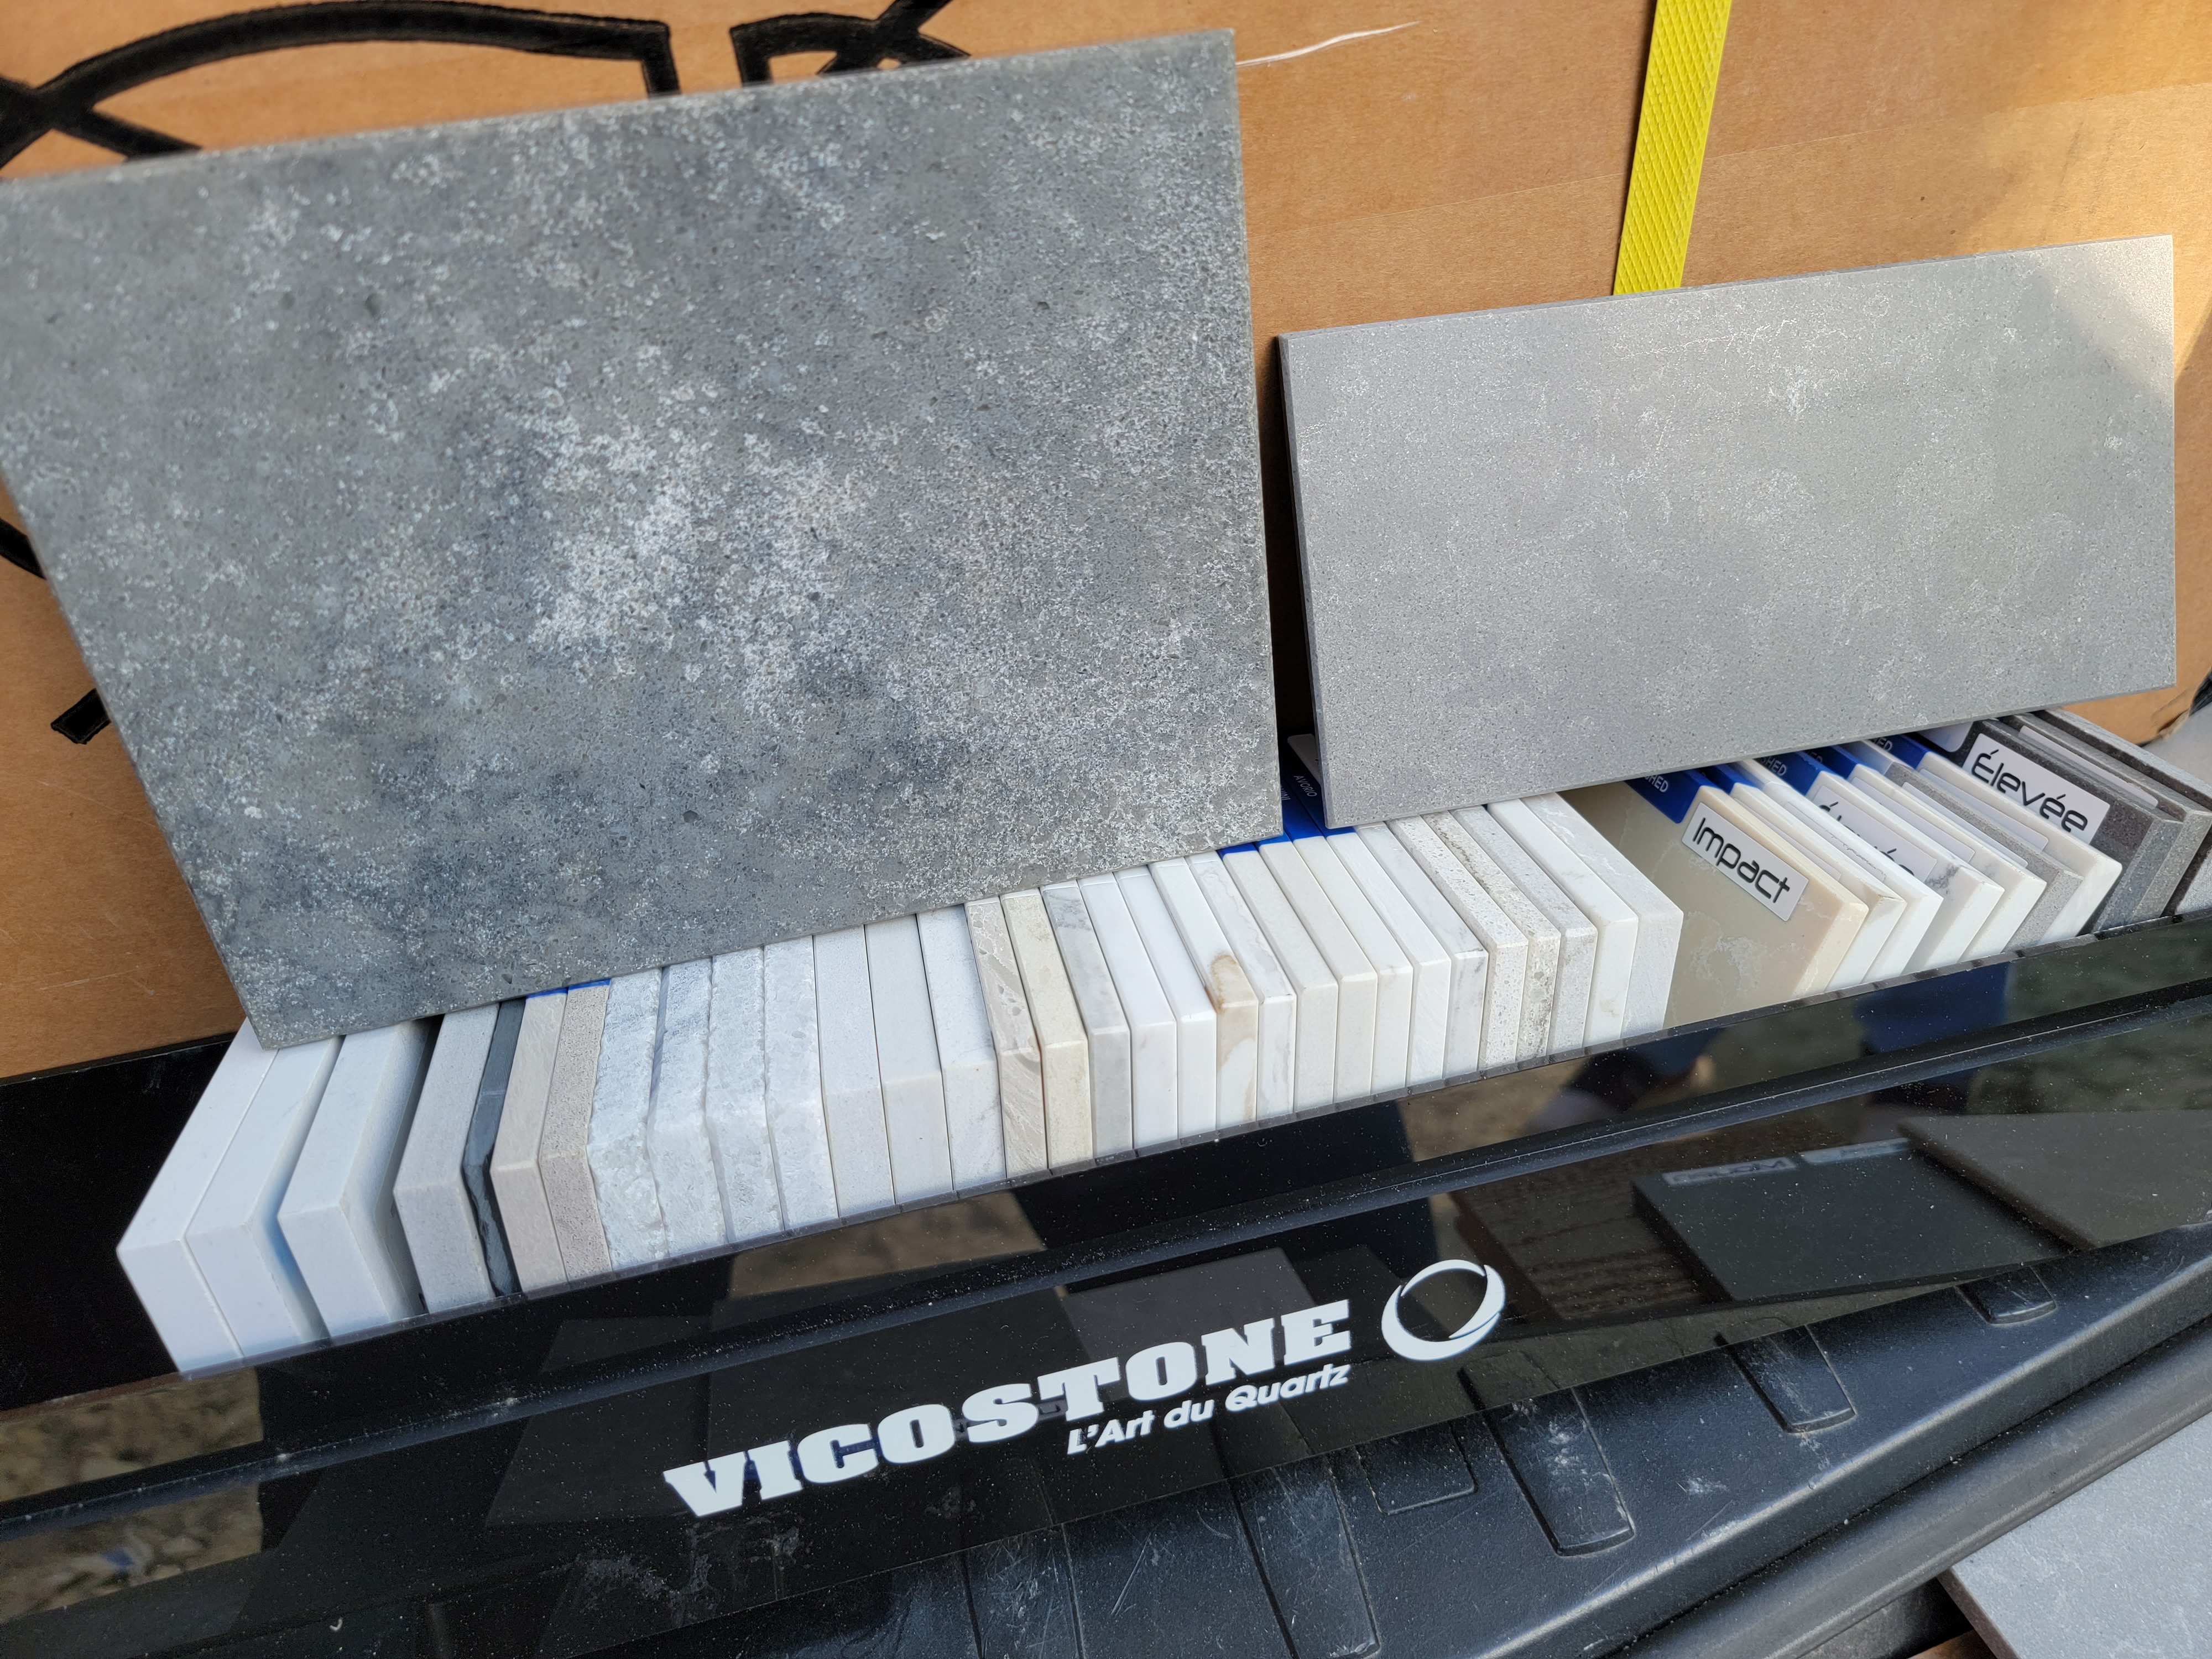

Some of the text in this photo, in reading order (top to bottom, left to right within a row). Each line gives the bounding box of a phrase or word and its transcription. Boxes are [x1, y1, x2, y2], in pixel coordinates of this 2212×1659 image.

[1293, 775, 1318, 797] AVORIO
[1971, 749, 2088, 833] Élevée
[1692, 817, 1791, 904] Impact
[663, 1300, 1352, 1516] VICOSTONE
[1067, 1364, 1352, 1455] L'Art du Quartz
